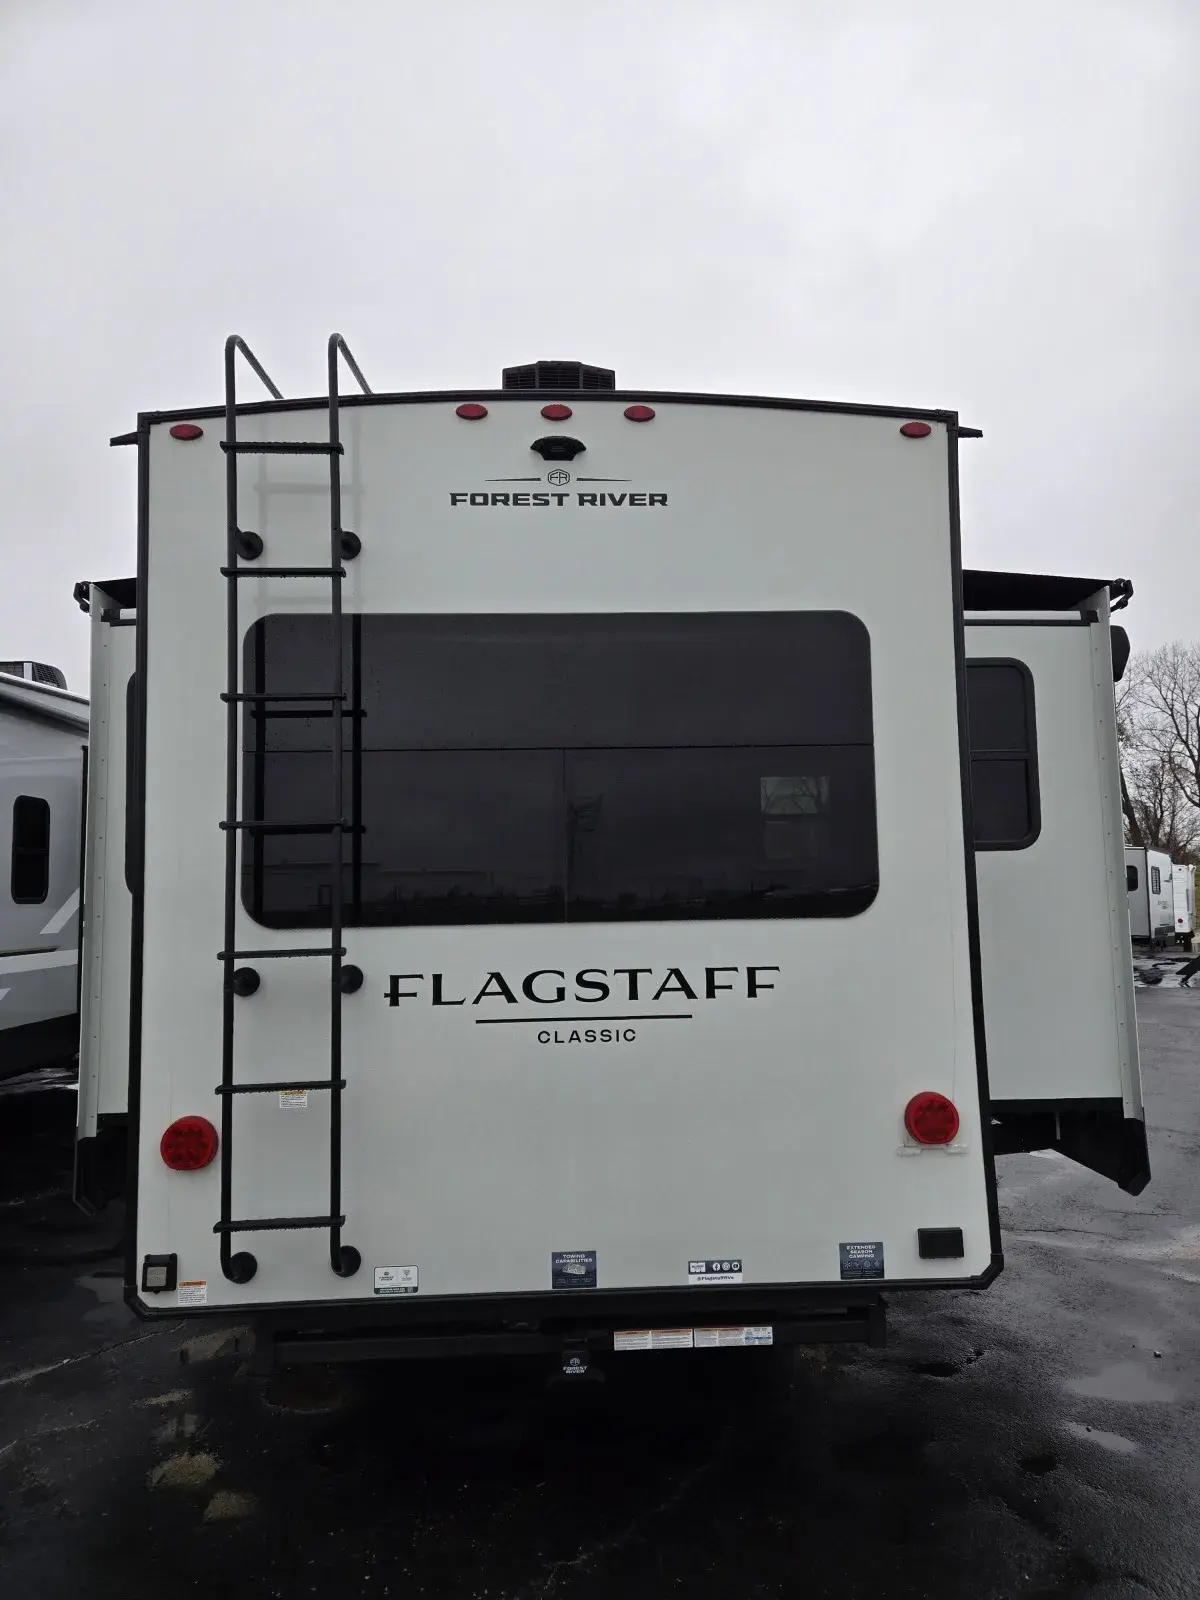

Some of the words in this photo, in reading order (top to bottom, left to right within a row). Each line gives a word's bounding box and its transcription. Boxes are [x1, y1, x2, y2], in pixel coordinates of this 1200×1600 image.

[449, 492, 570, 507] FOREST
[577, 492, 669, 507] RIVER
[383, 966, 781, 1007] FLAGSTAFF
[537, 1028, 637, 1045] CLASSIC
